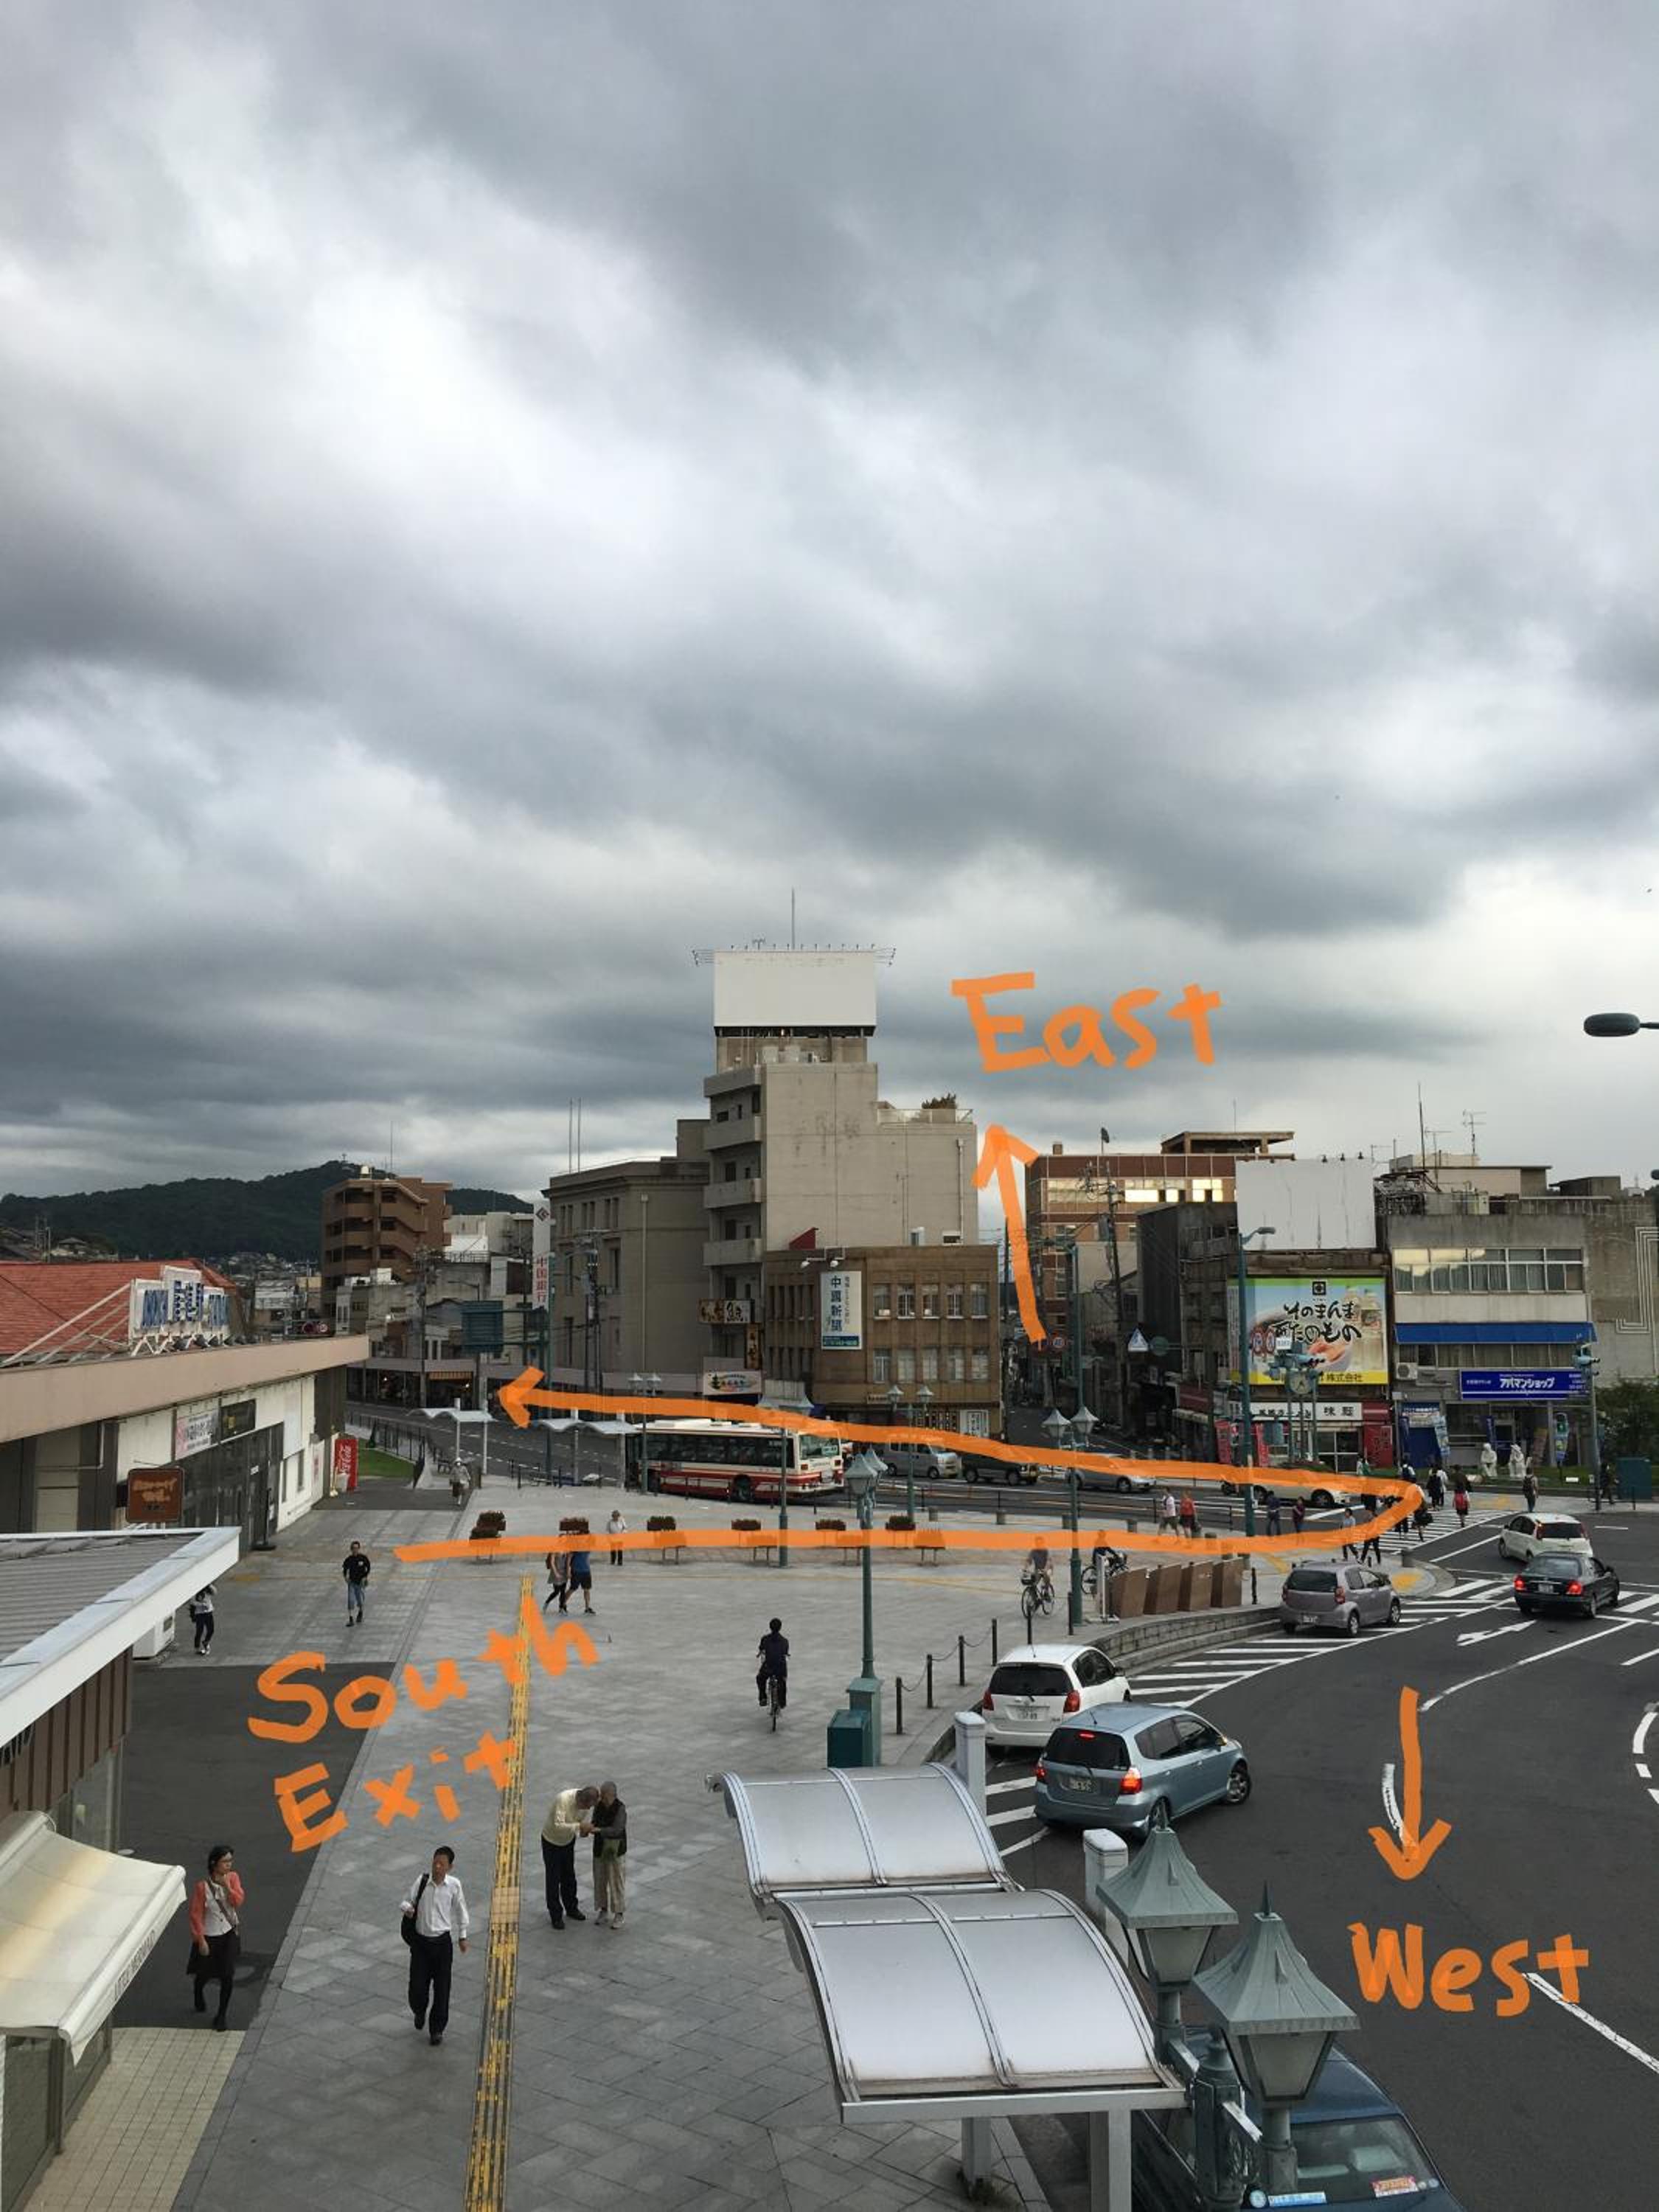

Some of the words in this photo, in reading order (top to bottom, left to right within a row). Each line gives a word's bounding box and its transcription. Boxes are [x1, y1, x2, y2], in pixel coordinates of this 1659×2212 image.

[536, 1256, 547, 1303] 中国銀行
[1283, 1300, 1354, 1320] そのまんま
[1499, 1377, 1555, 1389] アパマンショップ
